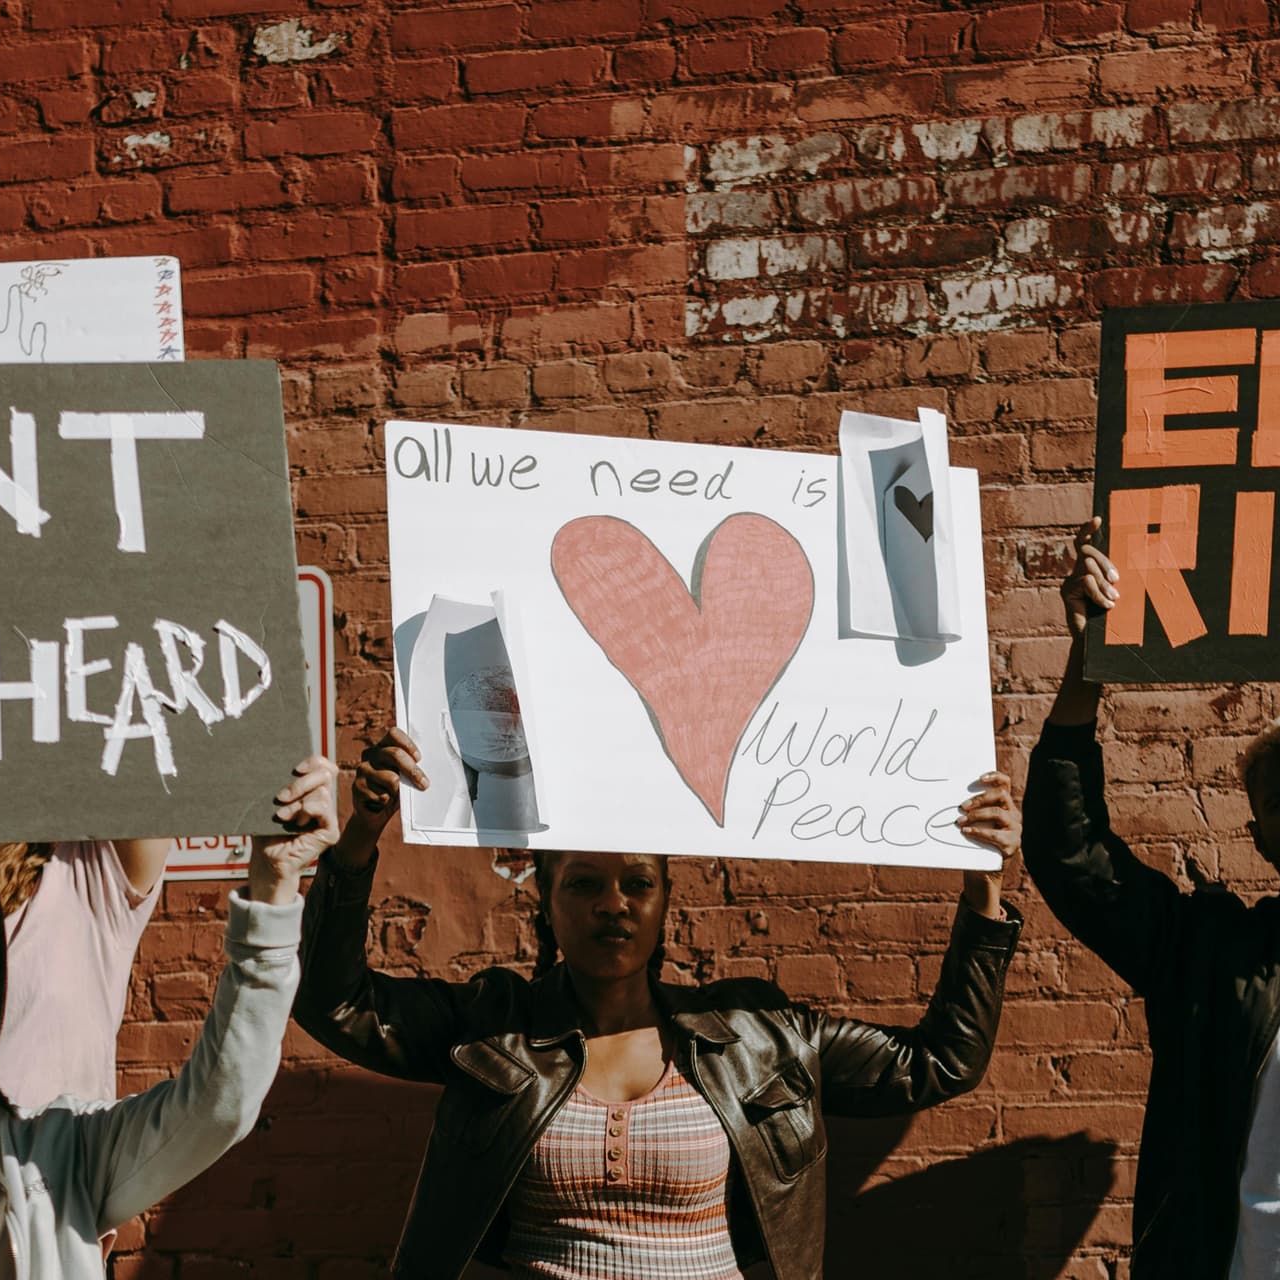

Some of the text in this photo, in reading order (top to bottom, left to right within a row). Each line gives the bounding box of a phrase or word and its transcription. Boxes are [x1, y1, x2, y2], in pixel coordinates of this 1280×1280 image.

[393, 427, 829, 508] all we need is
[741, 698, 949, 782] World
[751, 768, 986, 850] Peace
